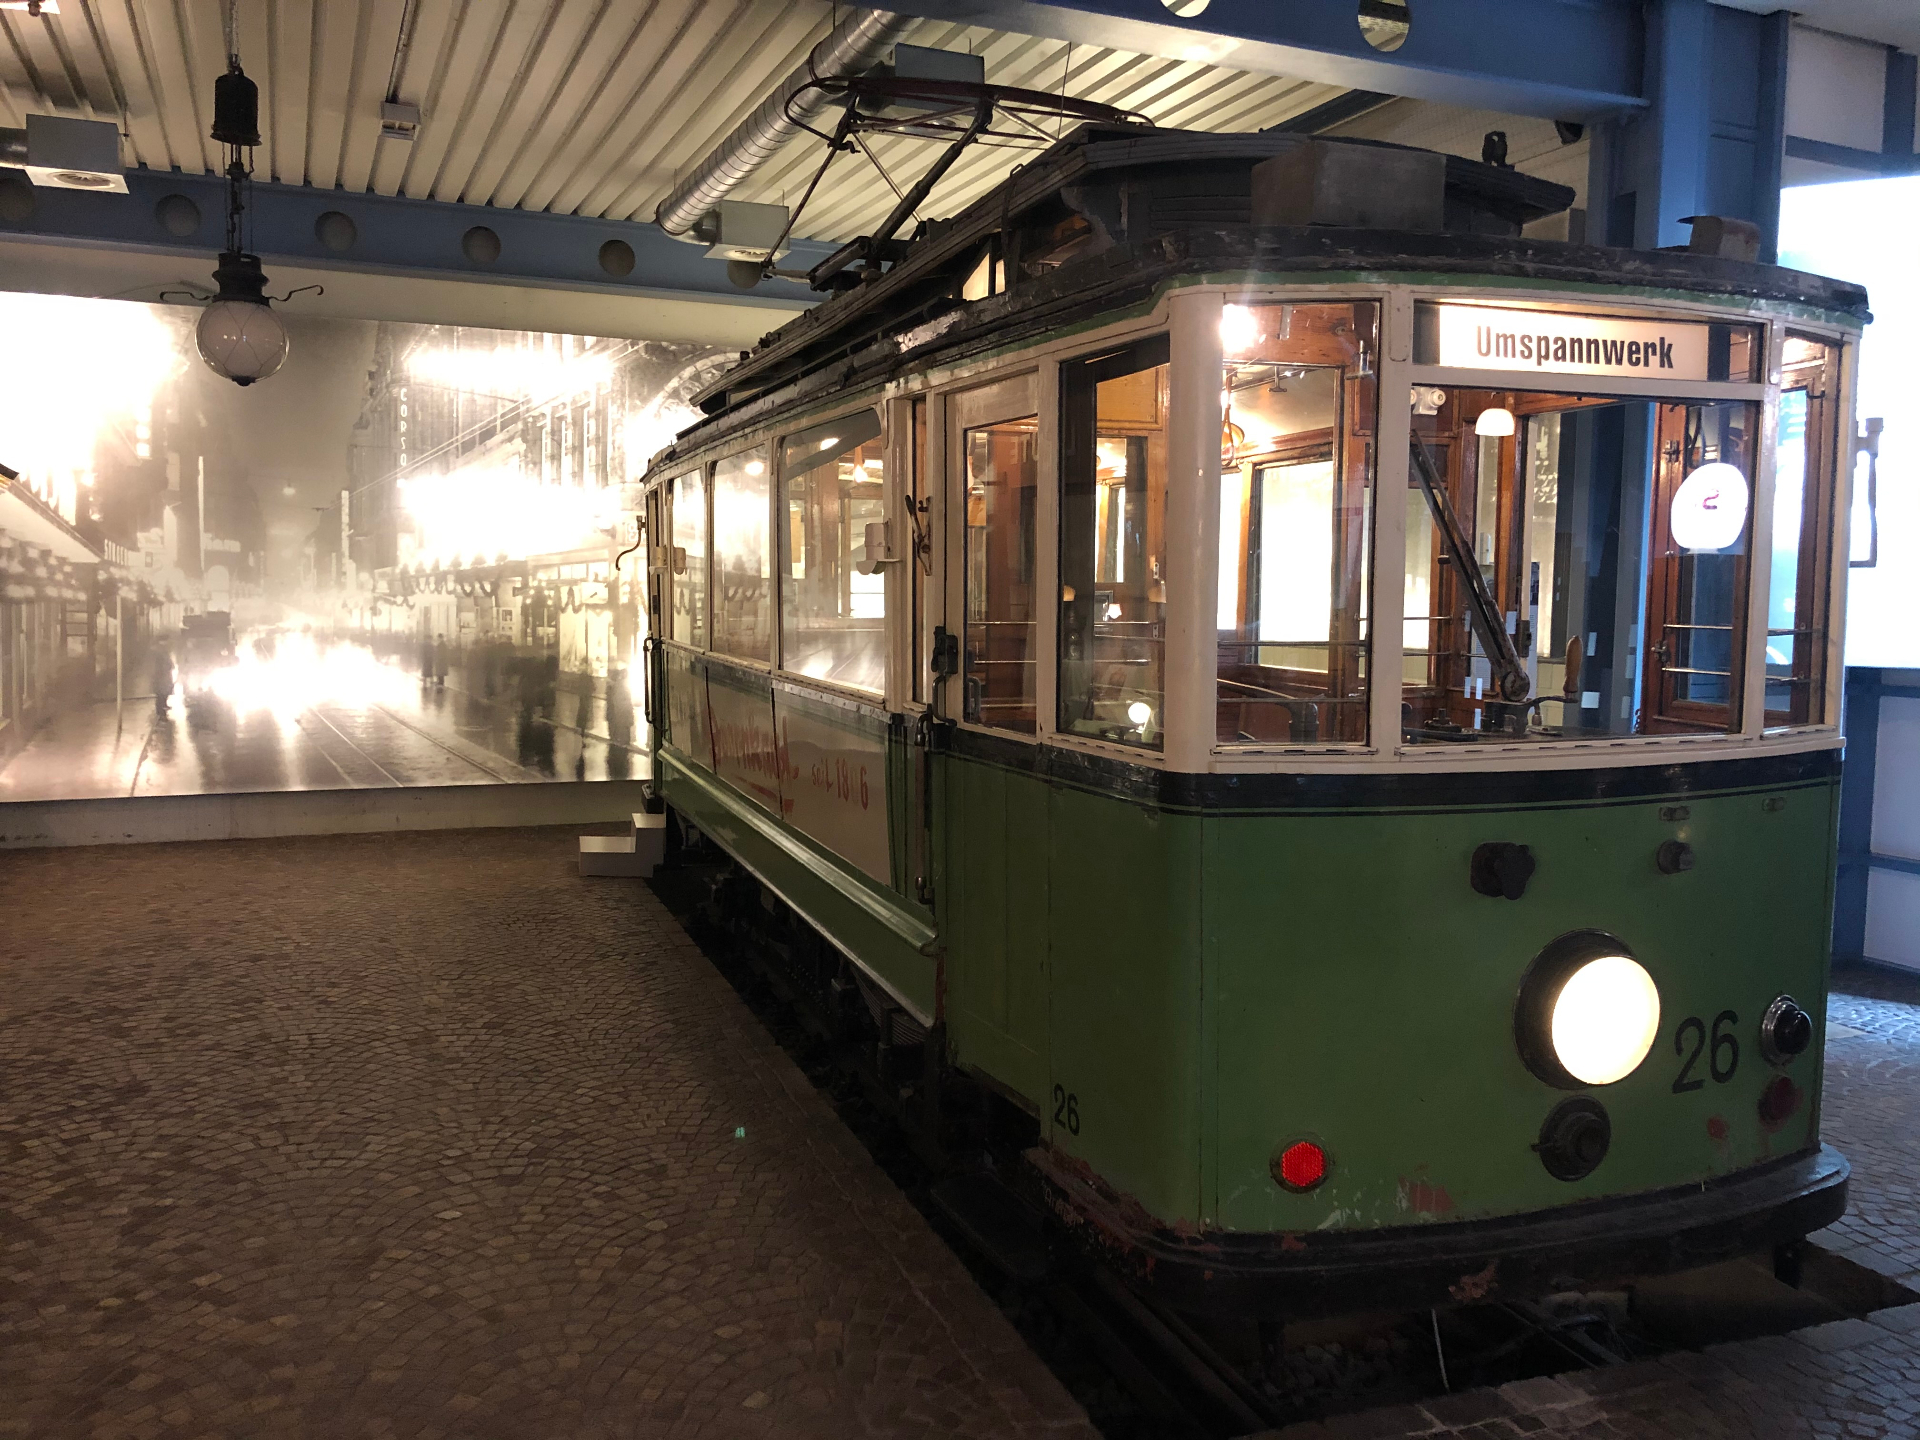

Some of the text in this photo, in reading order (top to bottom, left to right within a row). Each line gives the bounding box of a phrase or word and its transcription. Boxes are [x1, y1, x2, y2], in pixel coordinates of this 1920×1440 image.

[1475, 324, 1674, 370] Umspannwerk
[400, 387, 408, 467] CORSO
[835, 757, 869, 811] 186
[1671, 1009, 1739, 1095] 26
[1053, 1082, 1080, 1137] 26
